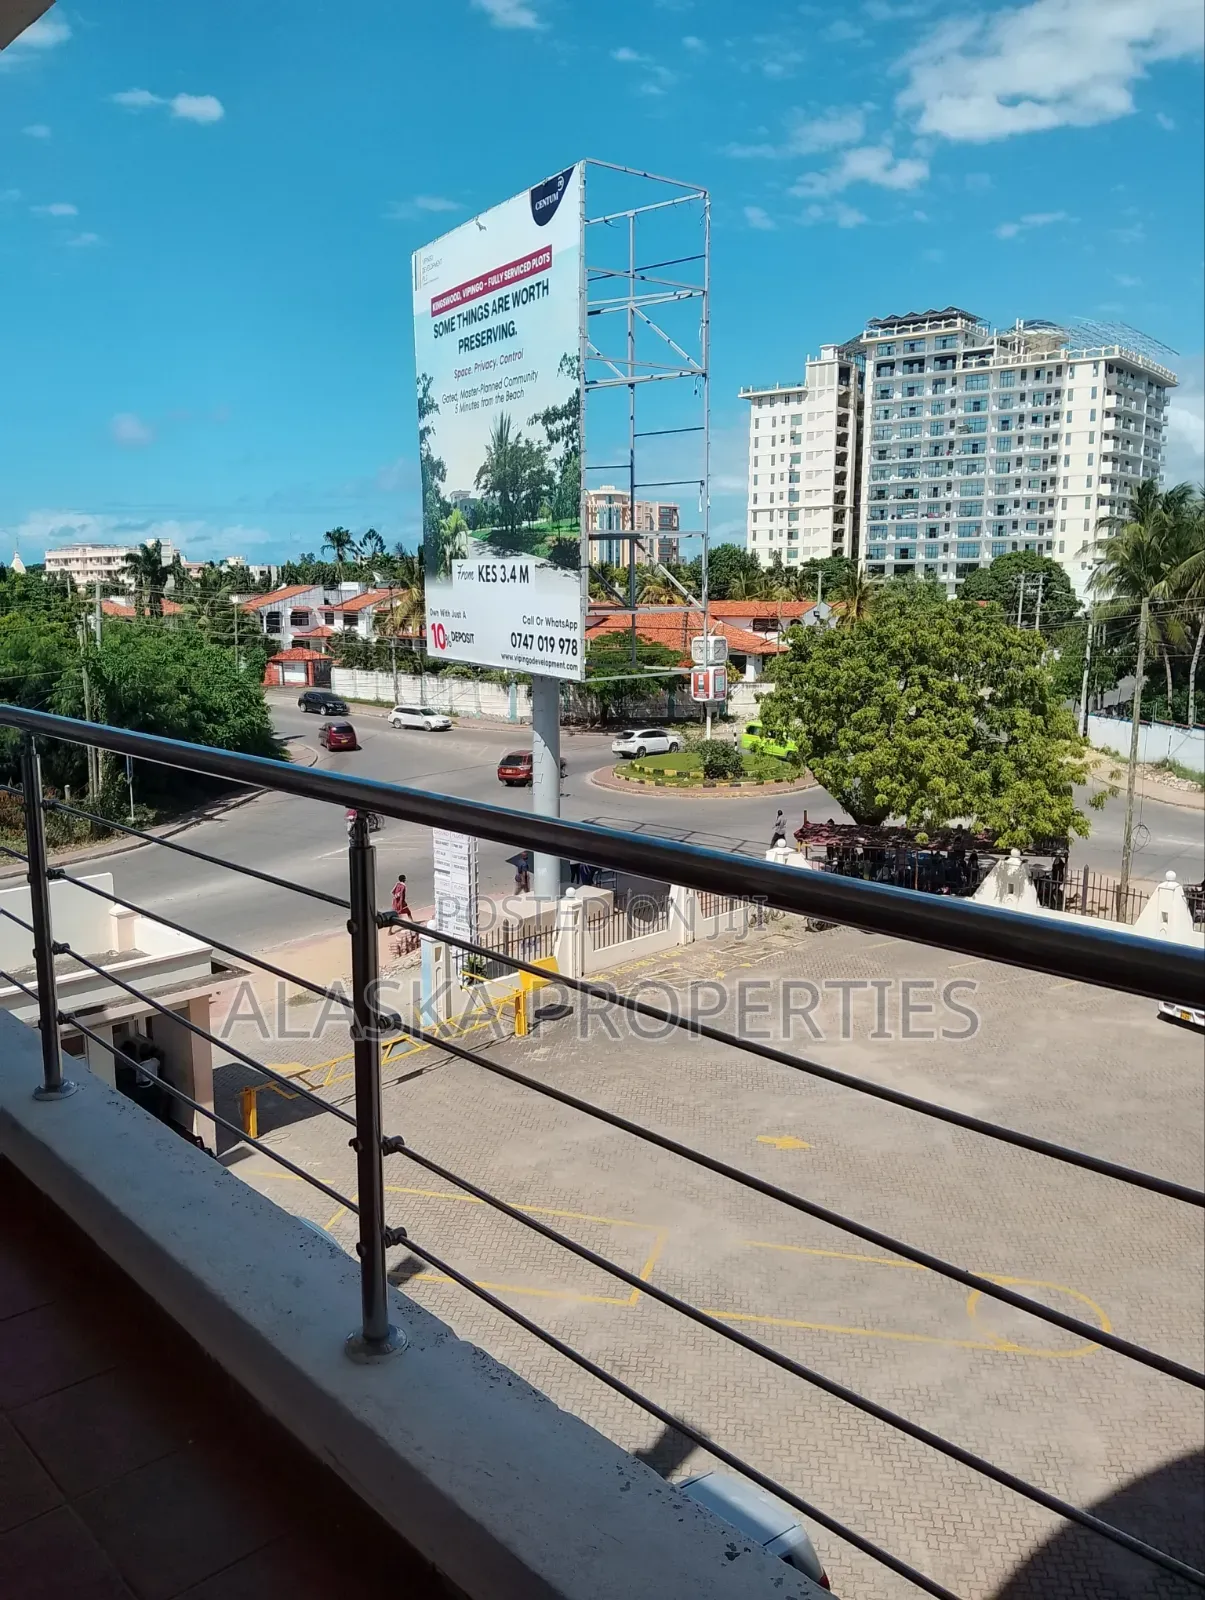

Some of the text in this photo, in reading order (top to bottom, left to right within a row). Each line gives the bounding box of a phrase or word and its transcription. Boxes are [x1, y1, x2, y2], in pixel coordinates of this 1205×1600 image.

[535, 191, 559, 210] CENTUM
[432, 291, 462, 312] KINGSWOOD,
[462, 281, 484, 298] VIPINGO
[487, 271, 504, 287] FULLY
[503, 260, 532, 280] SERVICED
[531, 251, 551, 269] PLOTS
[433, 278, 549, 339] SOME THINGS ARE WORTH
[458, 320, 518, 354] PRESERVING.
[500, 348, 524, 365] Control
[460, 379, 503, 400] Master-Planned
[503, 369, 539, 388] Community
[459, 399, 480, 414] Minutes
[481, 396, 494, 408] from
[495, 391, 505, 404] the
[505, 387, 525, 402] Beach
[457, 563, 529, 583] From KES 3.4 M
[430, 608, 439, 616] Own
[440, 609, 451, 617] With
[452, 610, 462, 619] Just
[522, 615, 578, 632] Call Or WhatsApp
[451, 630, 475, 644] DEPOSIT
[510, 632, 578, 656] 0747 019 978
[501, 653, 579, 671] www.vipingodevelopment.com
